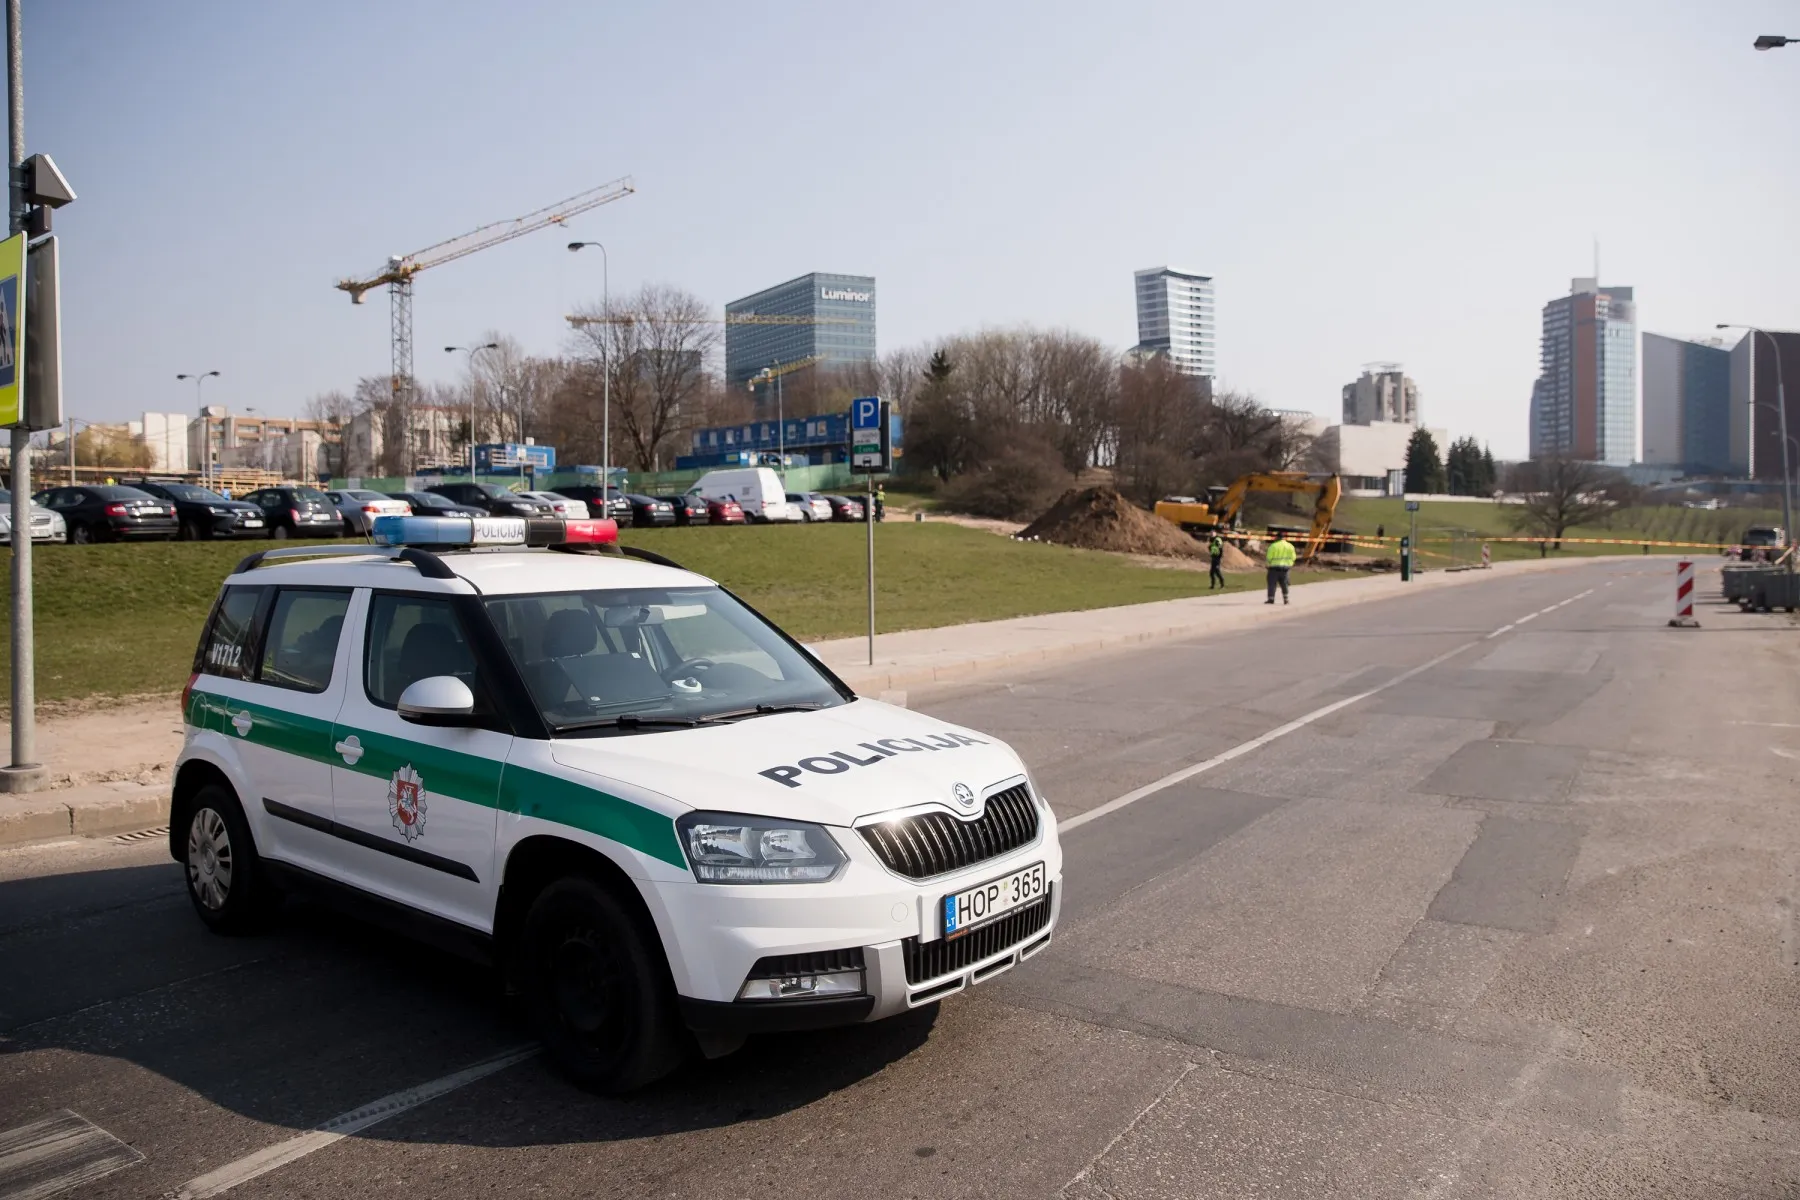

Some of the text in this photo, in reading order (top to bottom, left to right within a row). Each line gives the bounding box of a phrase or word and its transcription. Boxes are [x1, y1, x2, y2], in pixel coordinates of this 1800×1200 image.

[821, 287, 870, 302] Luminor
[859, 401, 875, 426] P
[474, 523, 524, 539] POLICIJA
[211, 643, 242, 667] V1712
[757, 732, 991, 788] POLICIJA
[958, 885, 999, 925] HOP
[1011, 868, 1041, 902] 365
[946, 917, 955, 927] LT
